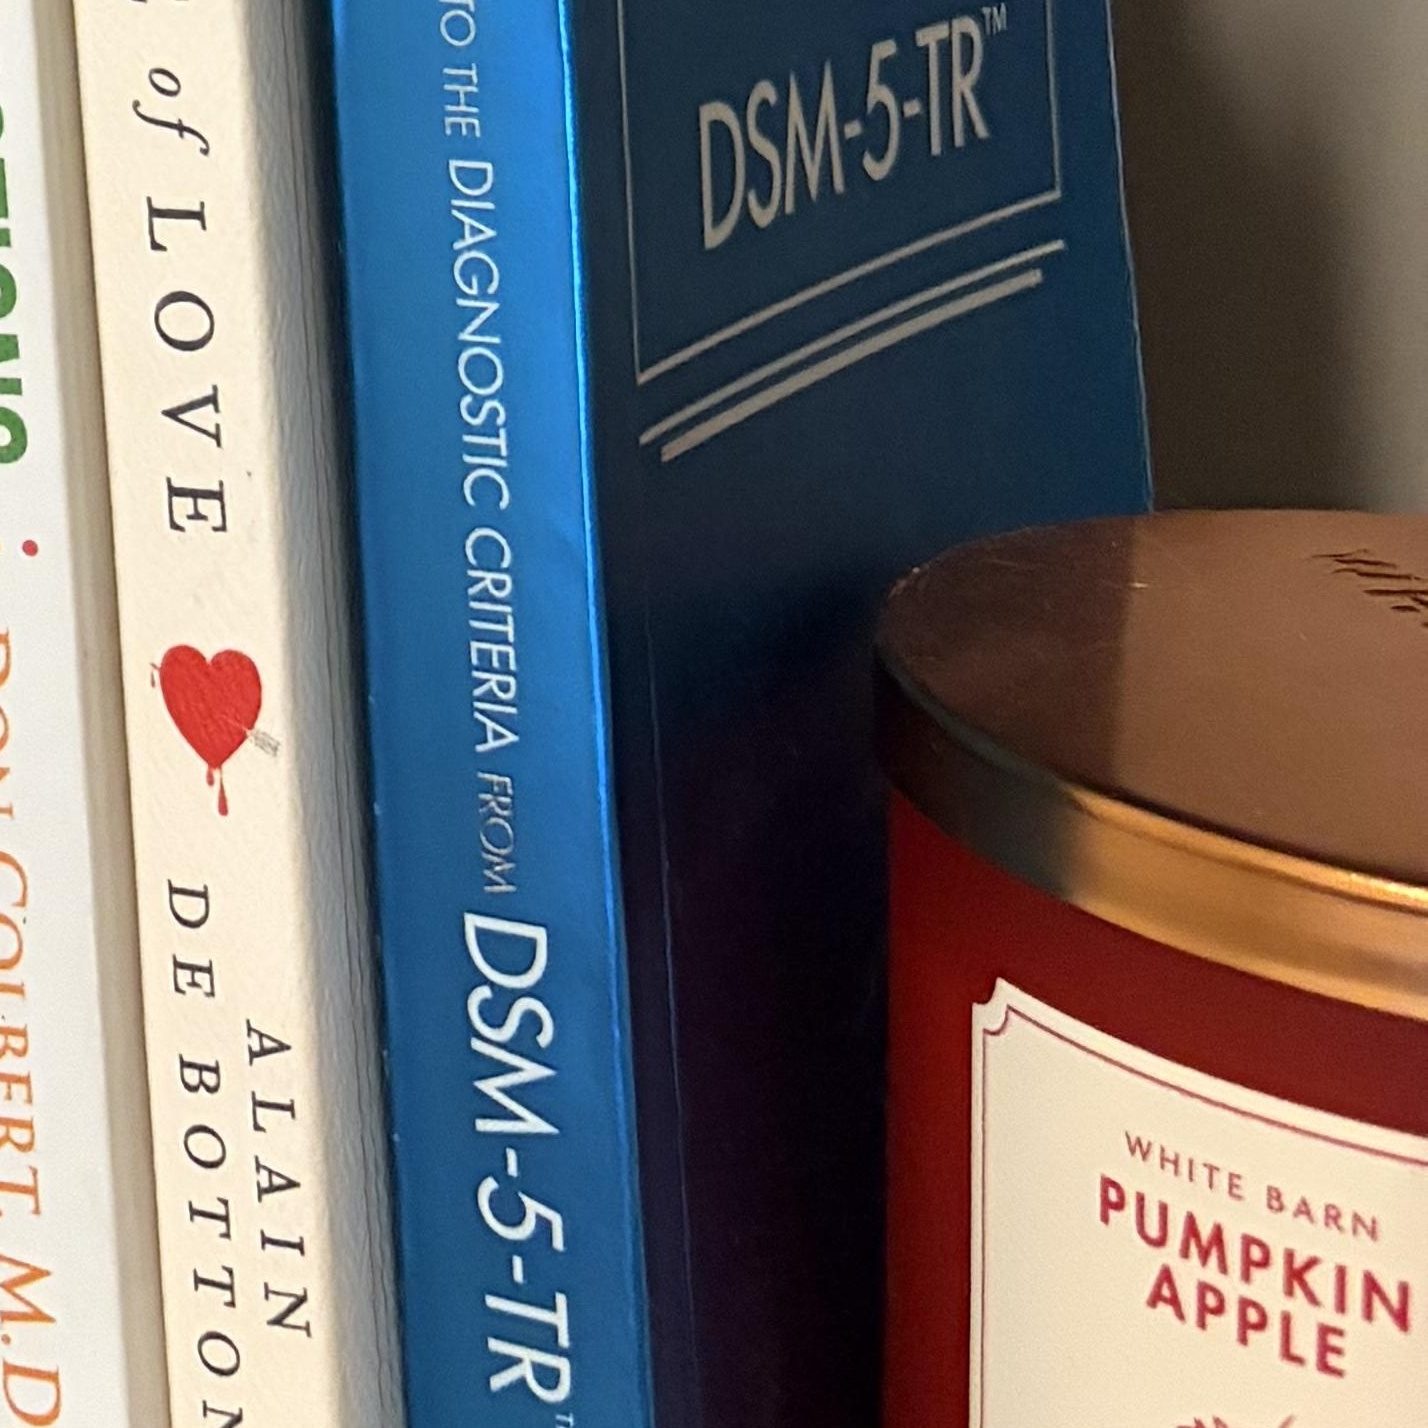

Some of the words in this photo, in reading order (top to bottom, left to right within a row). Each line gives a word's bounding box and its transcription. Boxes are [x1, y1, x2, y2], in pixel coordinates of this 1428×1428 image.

[133, 67, 210, 156] of
[442, 64, 480, 138] THE
[146, 195, 228, 533] LOVE
[449, 158, 510, 512] DIAGNOSTIC
[464, 527, 520, 754] CRITERIA
[477, 771, 517, 896] FROM
[167, 878, 216, 998] DE
[246, 1019, 312, 1339] ALAIN
[1124, 1131, 1244, 1201] WHITE
[1265, 1185, 1379, 1242] BARN
[1099, 1173, 1412, 1334] PUMPKIN
[1146, 1262, 1346, 1379] APPLE
